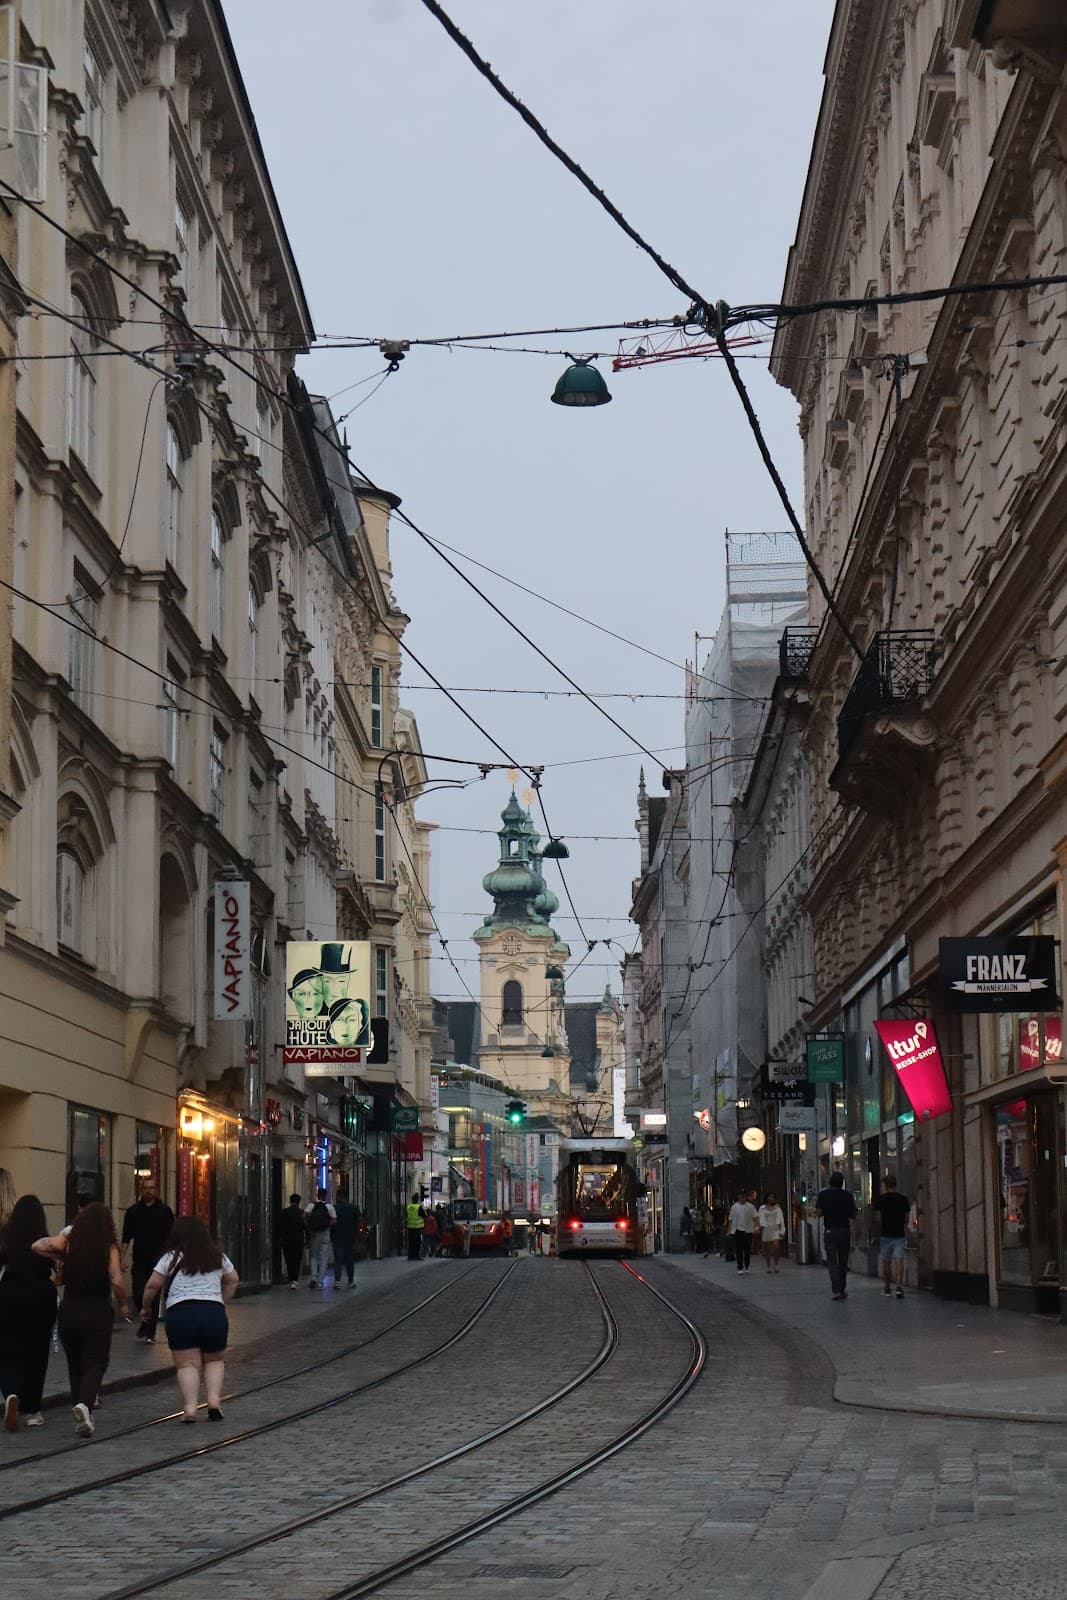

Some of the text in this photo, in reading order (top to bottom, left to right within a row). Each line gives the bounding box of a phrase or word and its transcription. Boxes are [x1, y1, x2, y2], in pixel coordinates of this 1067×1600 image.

[966, 954, 1027, 980] FRANZ
[284, 1048, 358, 1060] VAPIANO
[896, 1045, 937, 1071] REISE-SHOP
[773, 1065, 808, 1075] swatc
